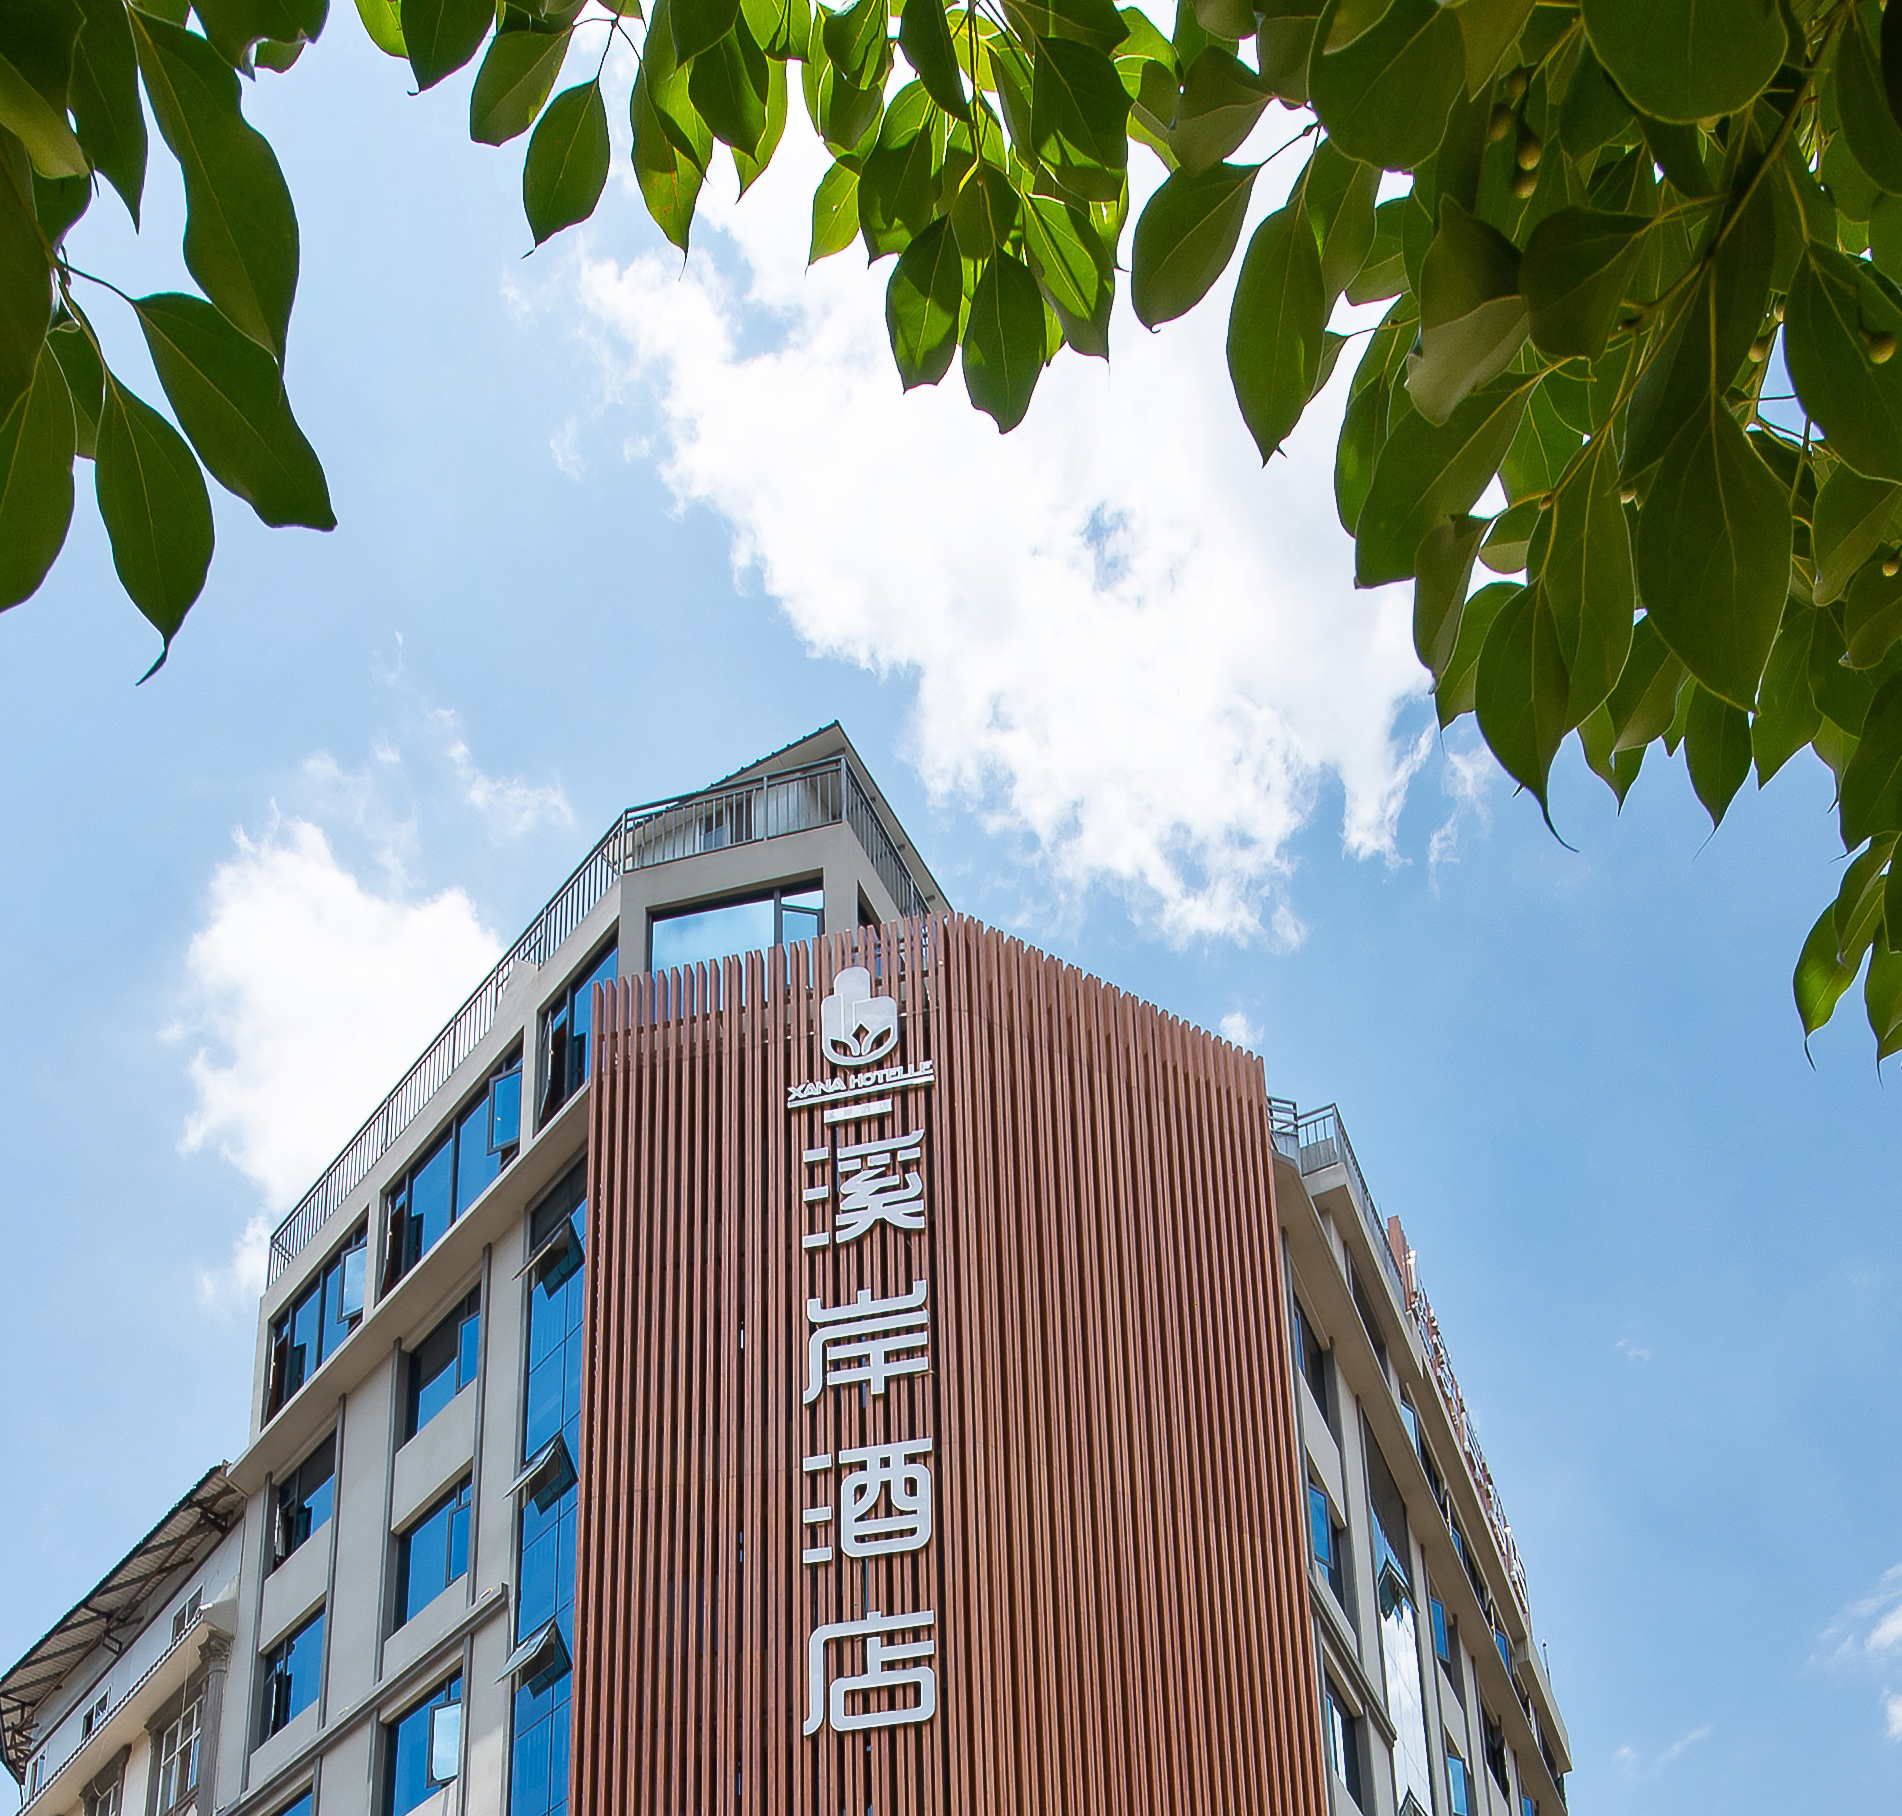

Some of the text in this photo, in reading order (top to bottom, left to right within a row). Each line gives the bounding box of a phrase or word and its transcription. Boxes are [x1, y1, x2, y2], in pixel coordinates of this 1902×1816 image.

[787, 1060, 934, 1101] XANA HOTELLE
[802, 1127, 937, 1737] 溪岸酒店
